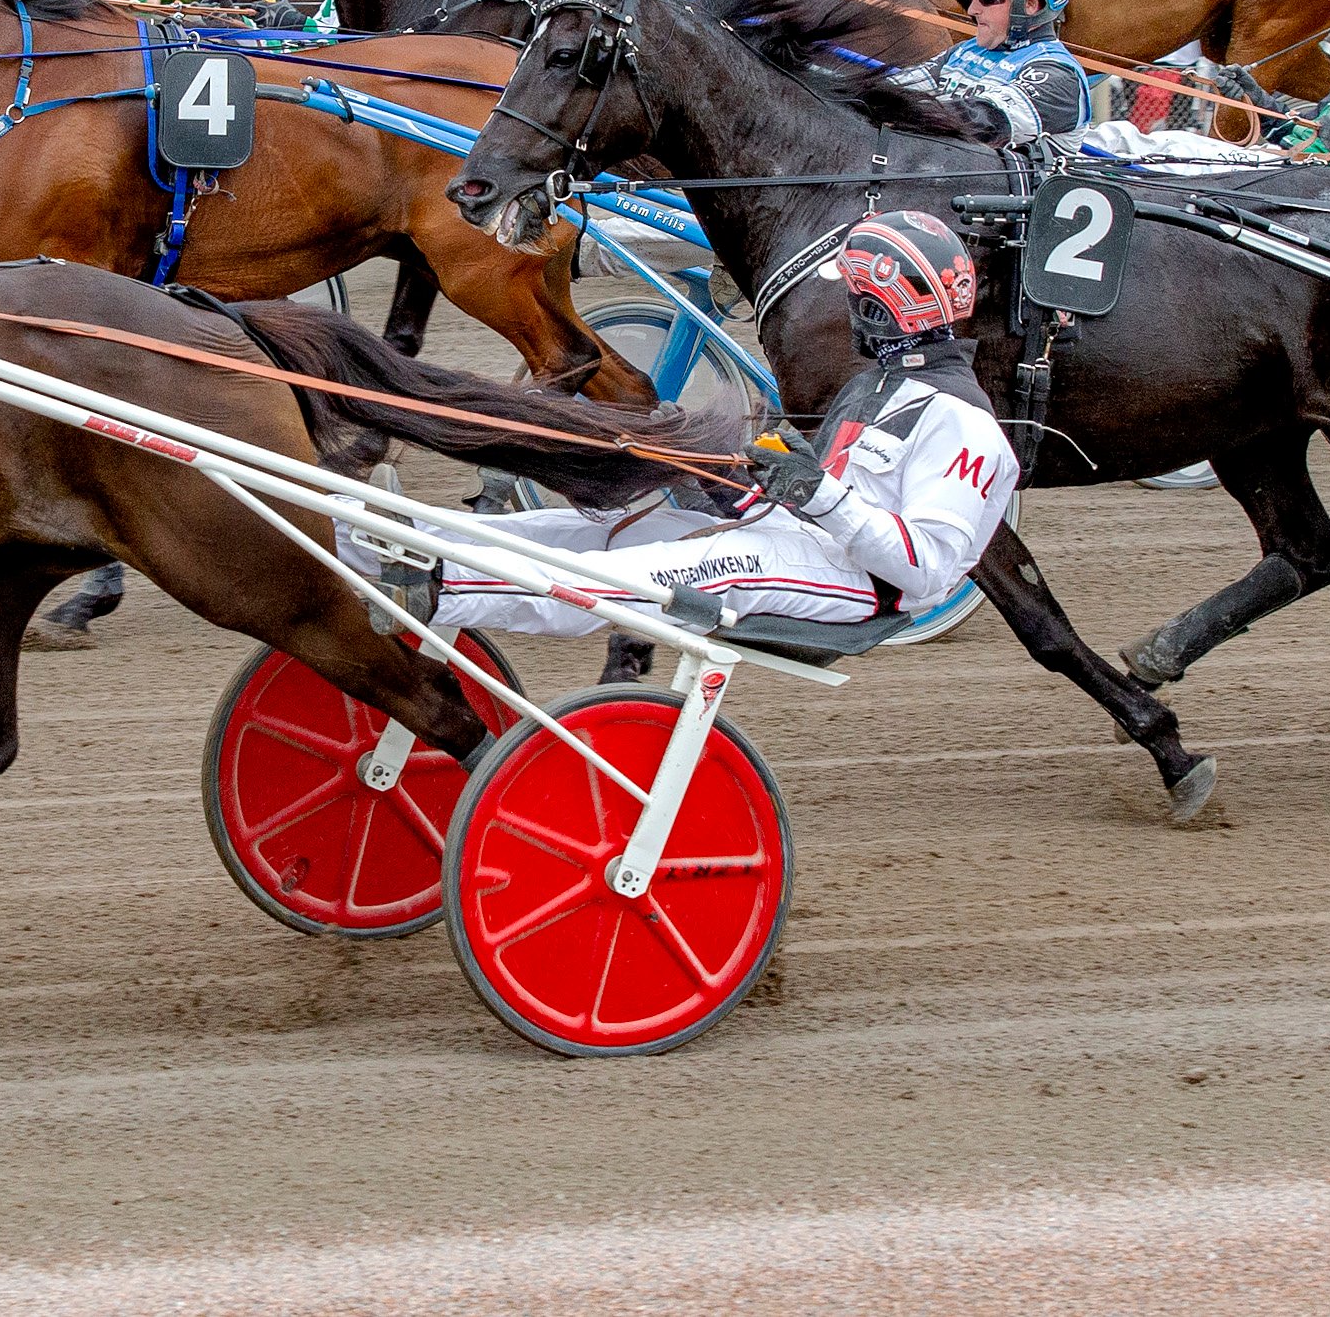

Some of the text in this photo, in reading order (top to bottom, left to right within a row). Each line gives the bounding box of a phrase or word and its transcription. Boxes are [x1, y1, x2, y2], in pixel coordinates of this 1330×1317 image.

[177, 58, 236, 136] 4
[615, 196, 650, 218] Team
[1044, 187, 1113, 282] 2
